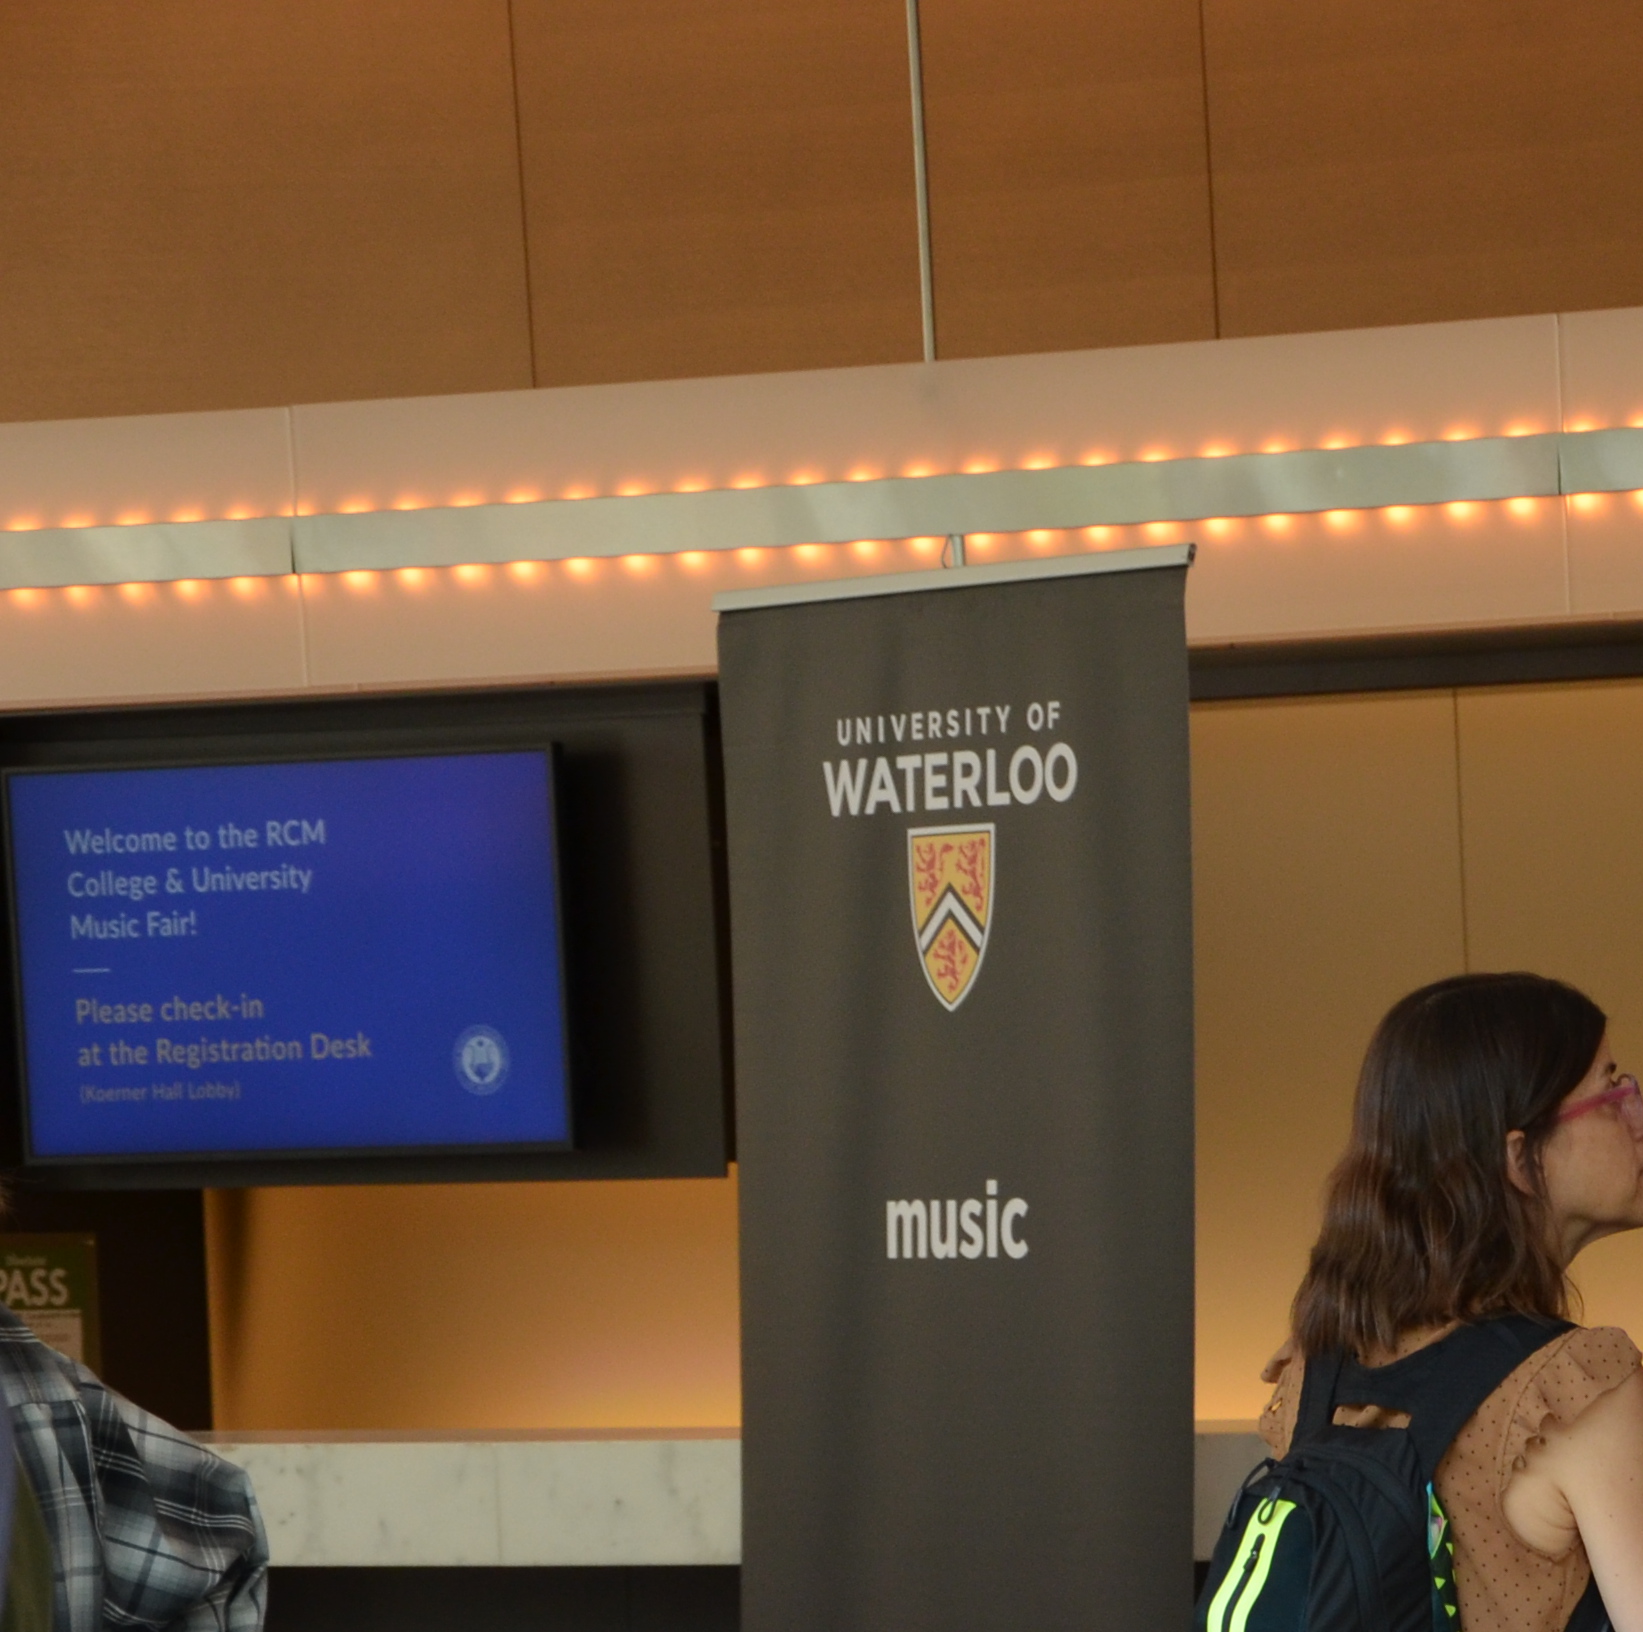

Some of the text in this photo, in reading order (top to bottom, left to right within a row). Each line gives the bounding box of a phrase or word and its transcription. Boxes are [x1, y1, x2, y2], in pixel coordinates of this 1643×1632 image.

[836, 701, 1061, 746] UNIVERSITY OF
[823, 743, 1078, 817] WATERLOO
[64, 819, 325, 854] Welcome to the RCM
[67, 863, 312, 900] College & University
[70, 910, 197, 939] Music Fair!
[75, 994, 264, 1024] Please check-in
[78, 1031, 372, 1069] at the Registration Desk
[152, 1082, 182, 1100] Hall
[188, 1080, 241, 1102] Lobby)
[886, 1179, 1028, 1259] music
